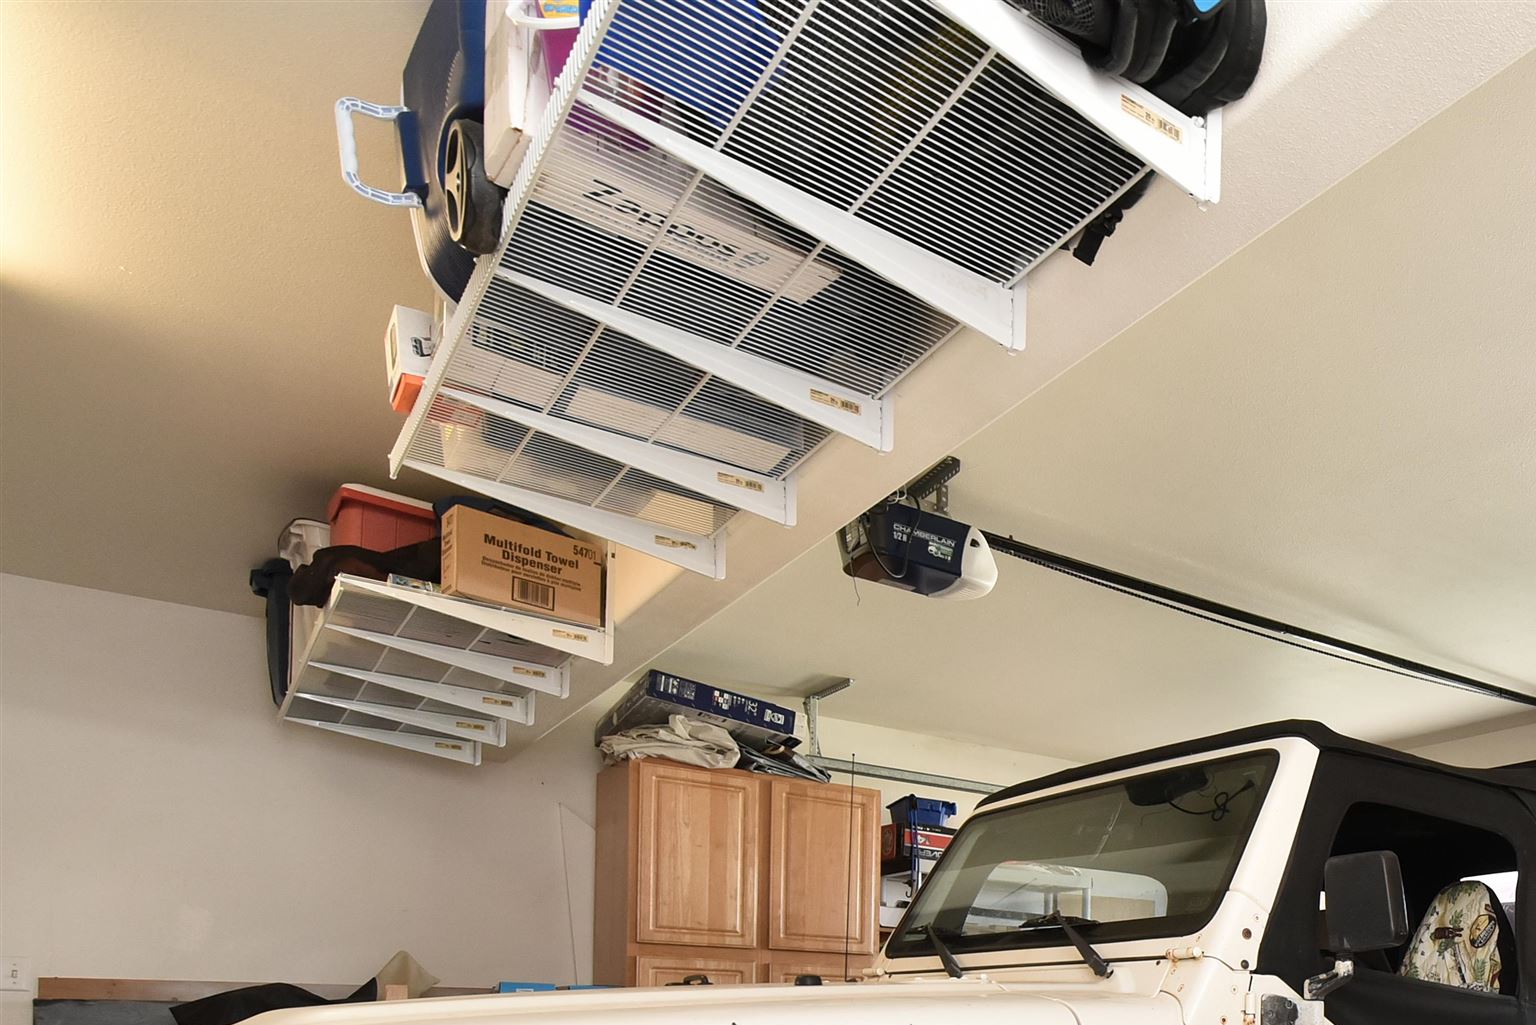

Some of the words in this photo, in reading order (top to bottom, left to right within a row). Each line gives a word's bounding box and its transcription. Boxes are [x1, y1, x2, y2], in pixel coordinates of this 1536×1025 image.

[893, 522, 956, 547] CHAMBERLAIN
[484, 533, 542, 559] Multifold
[545, 550, 579, 570] Towel
[502, 549, 563, 575] Dispenser
